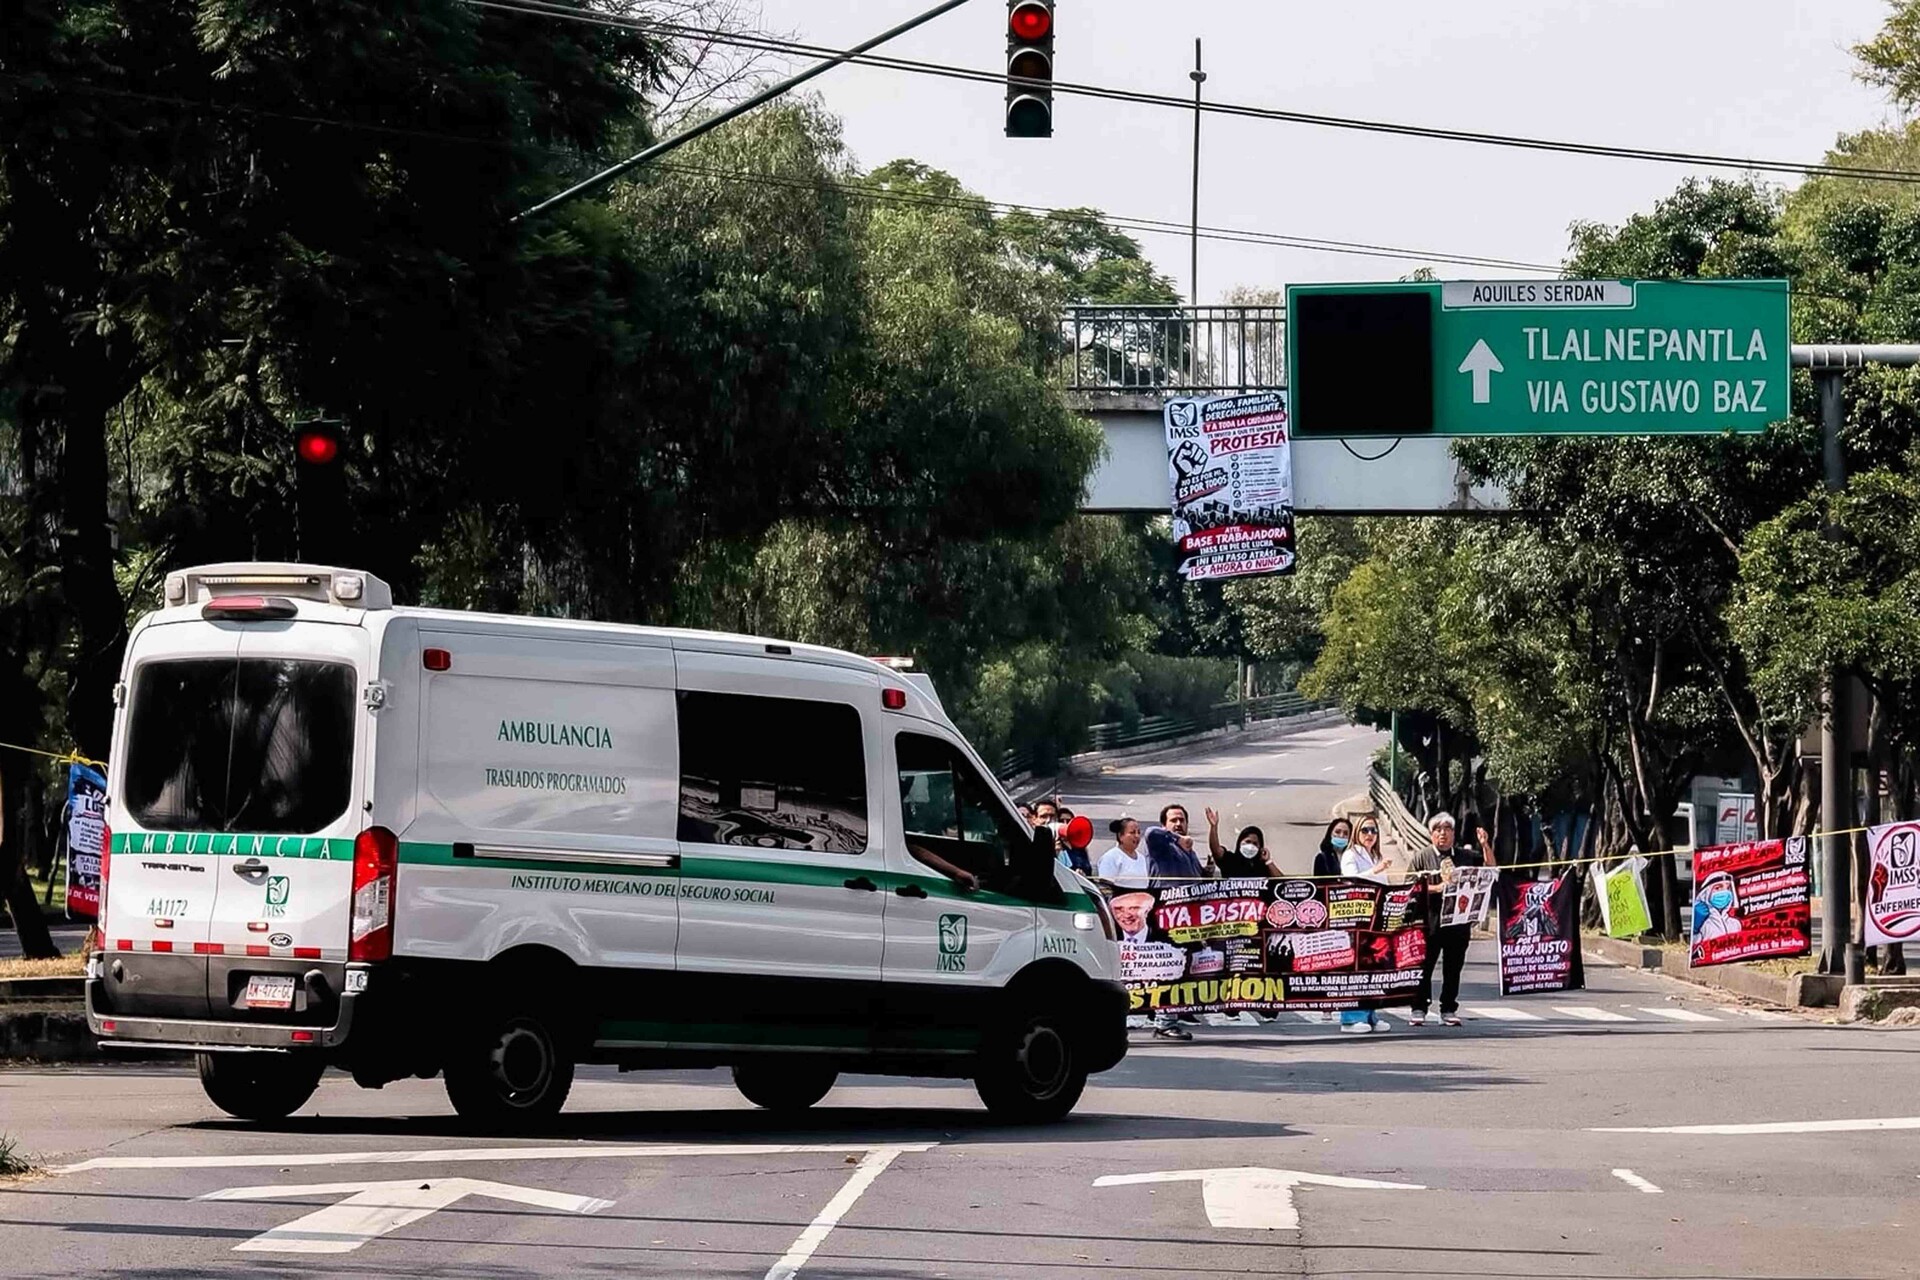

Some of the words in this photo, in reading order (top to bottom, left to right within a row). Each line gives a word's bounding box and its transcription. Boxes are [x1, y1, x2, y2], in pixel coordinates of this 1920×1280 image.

[1473, 285, 1536, 303] AQUILES
[1544, 284, 1605, 302] SERDAN
[1523, 327, 1767, 362] TLALNEPANTLA
[1527, 379, 1569, 413] VIA
[1581, 379, 1699, 414] GUSTAVO
[1713, 379, 1767, 413] BAZ
[1170, 427, 1200, 439] IMSS
[1205, 422, 1211, 431] Y
[1212, 422, 1218, 430] A
[1219, 419, 1236, 429] TODA
[1237, 417, 1246, 427] LA
[1210, 430, 1287, 455] PROTESTA
[1180, 488, 1189, 498] ES
[1190, 483, 1204, 495] POR
[1206, 476, 1227, 488] TODOS
[1181, 478, 1191, 487] NO
[1200, 473, 1213, 481] POR
[1186, 535, 1213, 549] BASE
[1216, 527, 1287, 544] TRABAJADORA
[1200, 546, 1218, 555] IMSS
[1220, 544, 1228, 552] EN
[1230, 543, 1240, 551] PIE
[1252, 540, 1274, 548] LUCHA
[1211, 555, 1223, 564] UN
[1226, 552, 1247, 562] PASO
[1249, 548, 1277, 559] ATRÁS!
[1190, 567, 1206, 578] ¡ES
[1210, 563, 1241, 575] AHORA
[1246, 561, 1253, 569] O
[1255, 556, 1288, 569] NUNCA!
[498, 720, 612, 749] AMBULANCIA
[486, 768, 545, 789] TRASLADOS
[547, 772, 626, 795] PROGRAMADOS
[124, 834, 331, 859] AMBULANCIA
[1722, 846, 1730, 858] 6
[1762, 872, 1775, 880] toca
[1890, 867, 1915, 886] IMSS
[73, 890, 82, 898] DE
[511, 875, 581, 891] INSTITUTO
[583, 879, 652, 895] MEXICANO
[654, 883, 677, 897] DEL
[680, 884, 731, 900] SEGURO
[732, 887, 776, 904] SOCIAL
[1782, 886, 1807, 897] trabajar
[147, 899, 187, 917] AA1172
[262, 904, 286, 919] IMSS
[1159, 907, 1191, 929] ¡YA
[1200, 901, 1264, 924] BASTA!
[1744, 905, 1749, 915] y
[1750, 901, 1773, 912] brindar
[1042, 934, 1078, 954] AA1172
[1502, 944, 1534, 957] SALARIO
[1535, 940, 1568, 955] JUSTO
[1516, 936, 1531, 945] POR
[1711, 946, 1741, 960] también
[1770, 941, 1779, 949] tu
[1780, 938, 1804, 949] lucha
[937, 954, 966, 973] IMSS
[1133, 960, 1183, 969] TRABAJADORA
[1524, 955, 1545, 965] DIGNO
[1289, 976, 1304, 985] DEL
[1305, 976, 1319, 985] DR.
